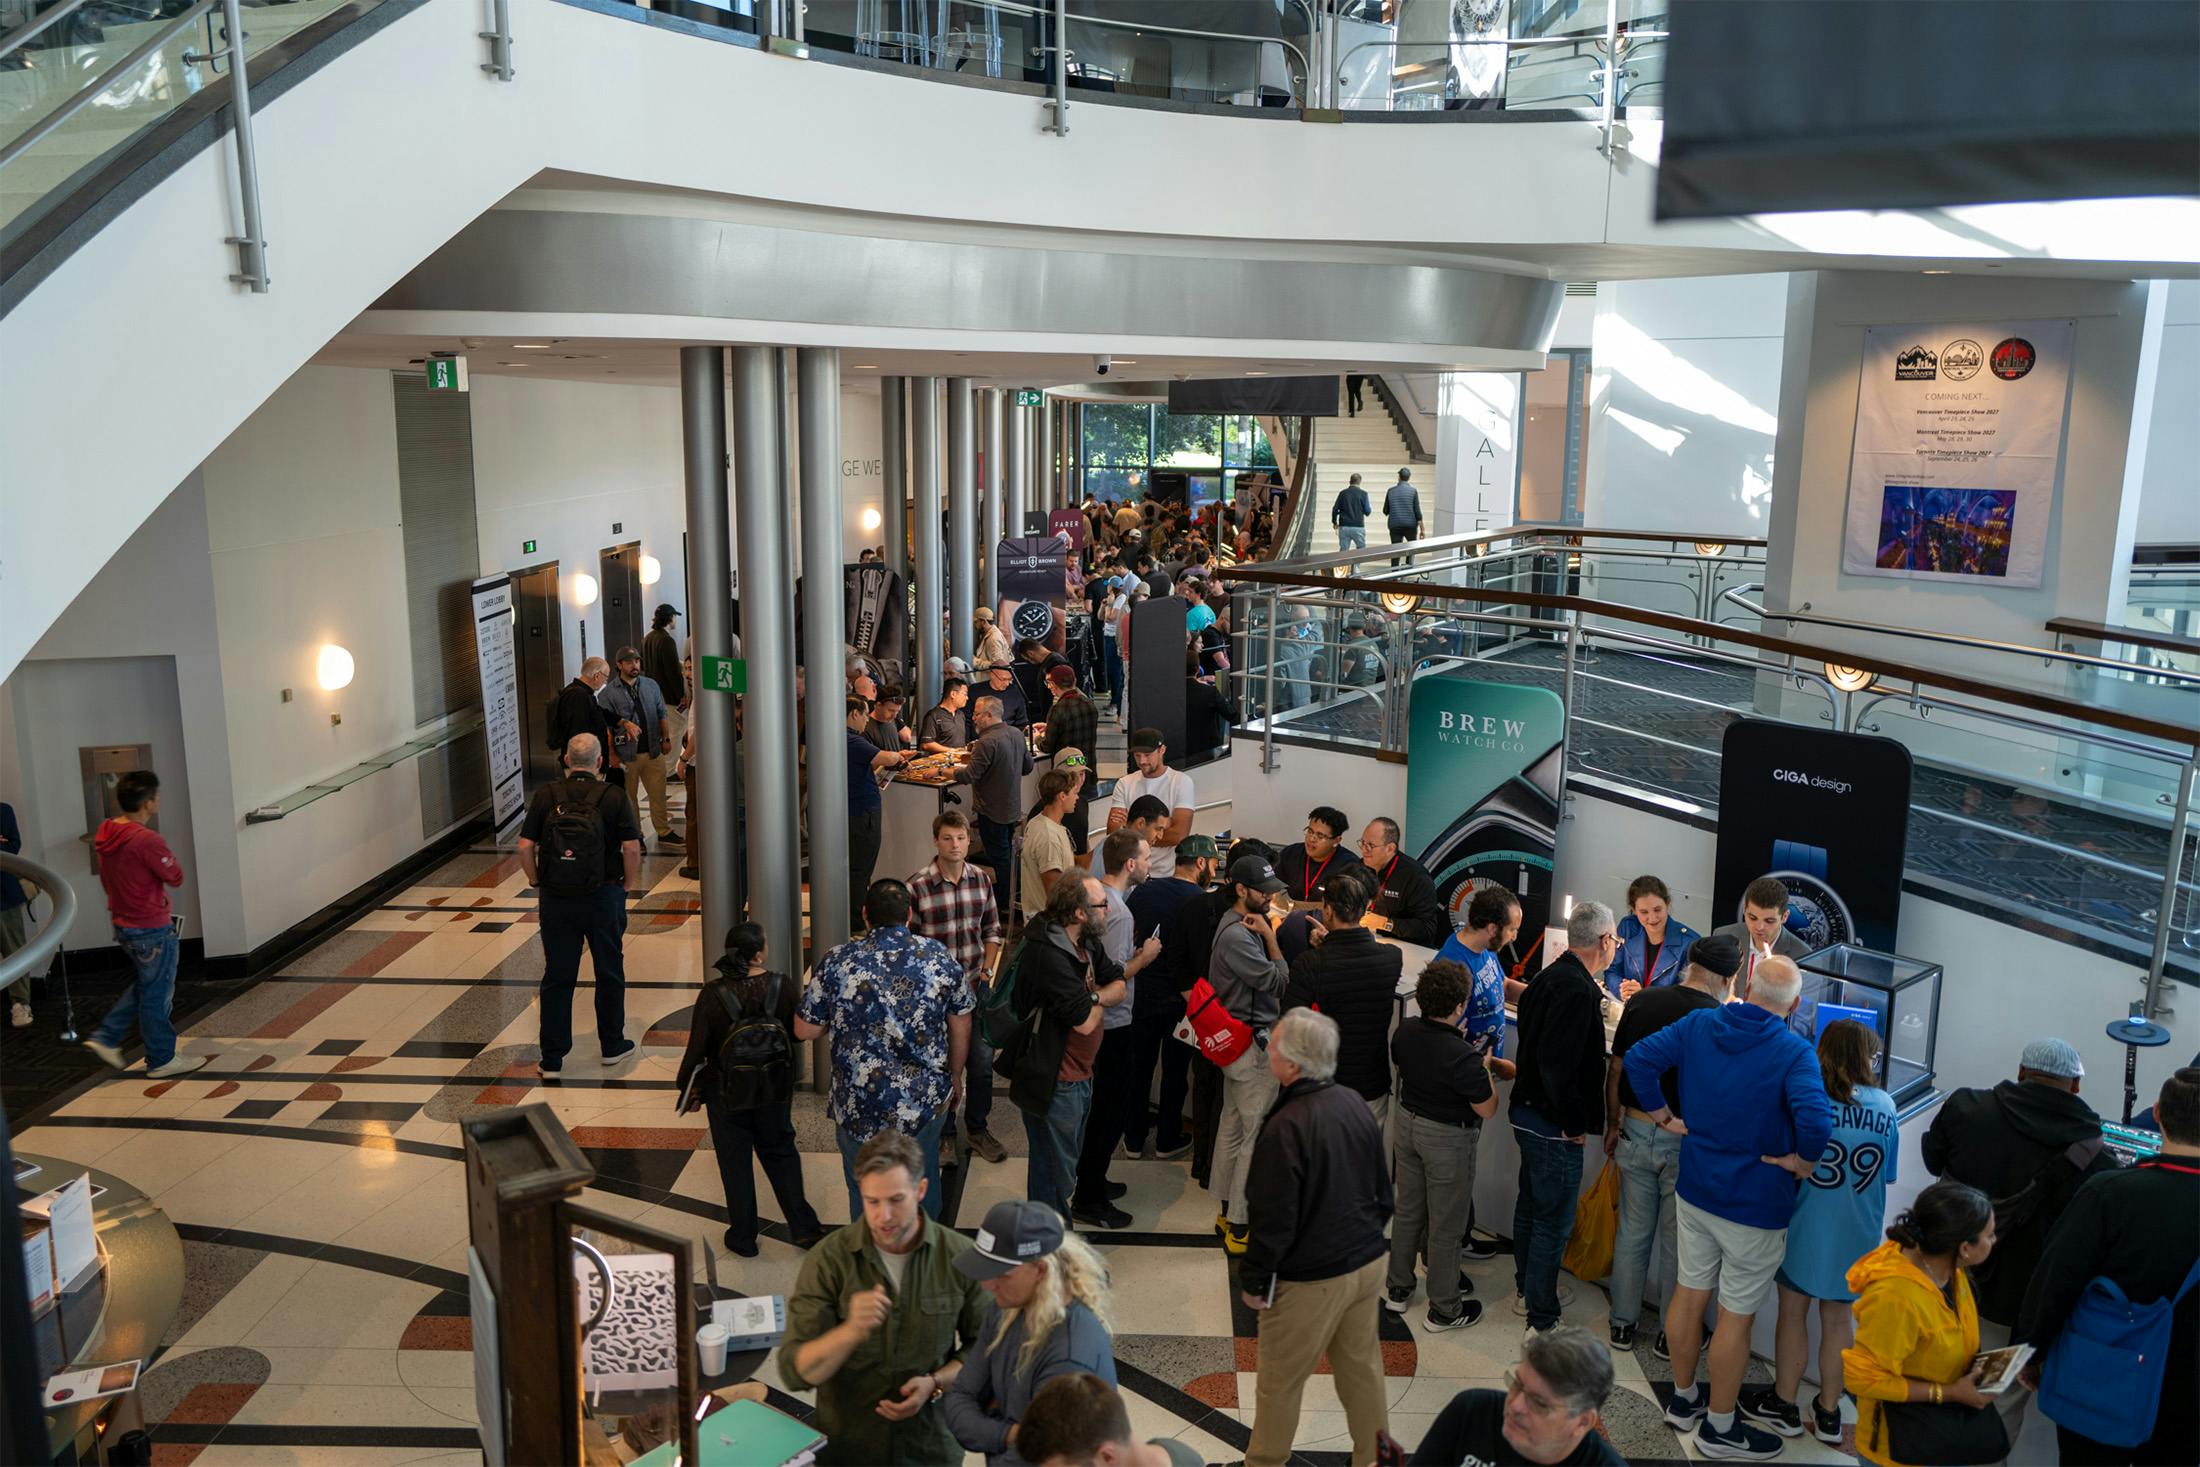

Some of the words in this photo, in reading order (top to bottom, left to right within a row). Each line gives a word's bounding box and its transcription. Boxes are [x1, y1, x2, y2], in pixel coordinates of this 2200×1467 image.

[1055, 520, 1079, 528] FARER
[1439, 711, 1526, 739] BREW
[1438, 731, 1495, 749] WATCH
[1773, 768, 1809, 785] CIGA
[1810, 775, 1852, 794] design
[1807, 1138, 1885, 1196] 39
